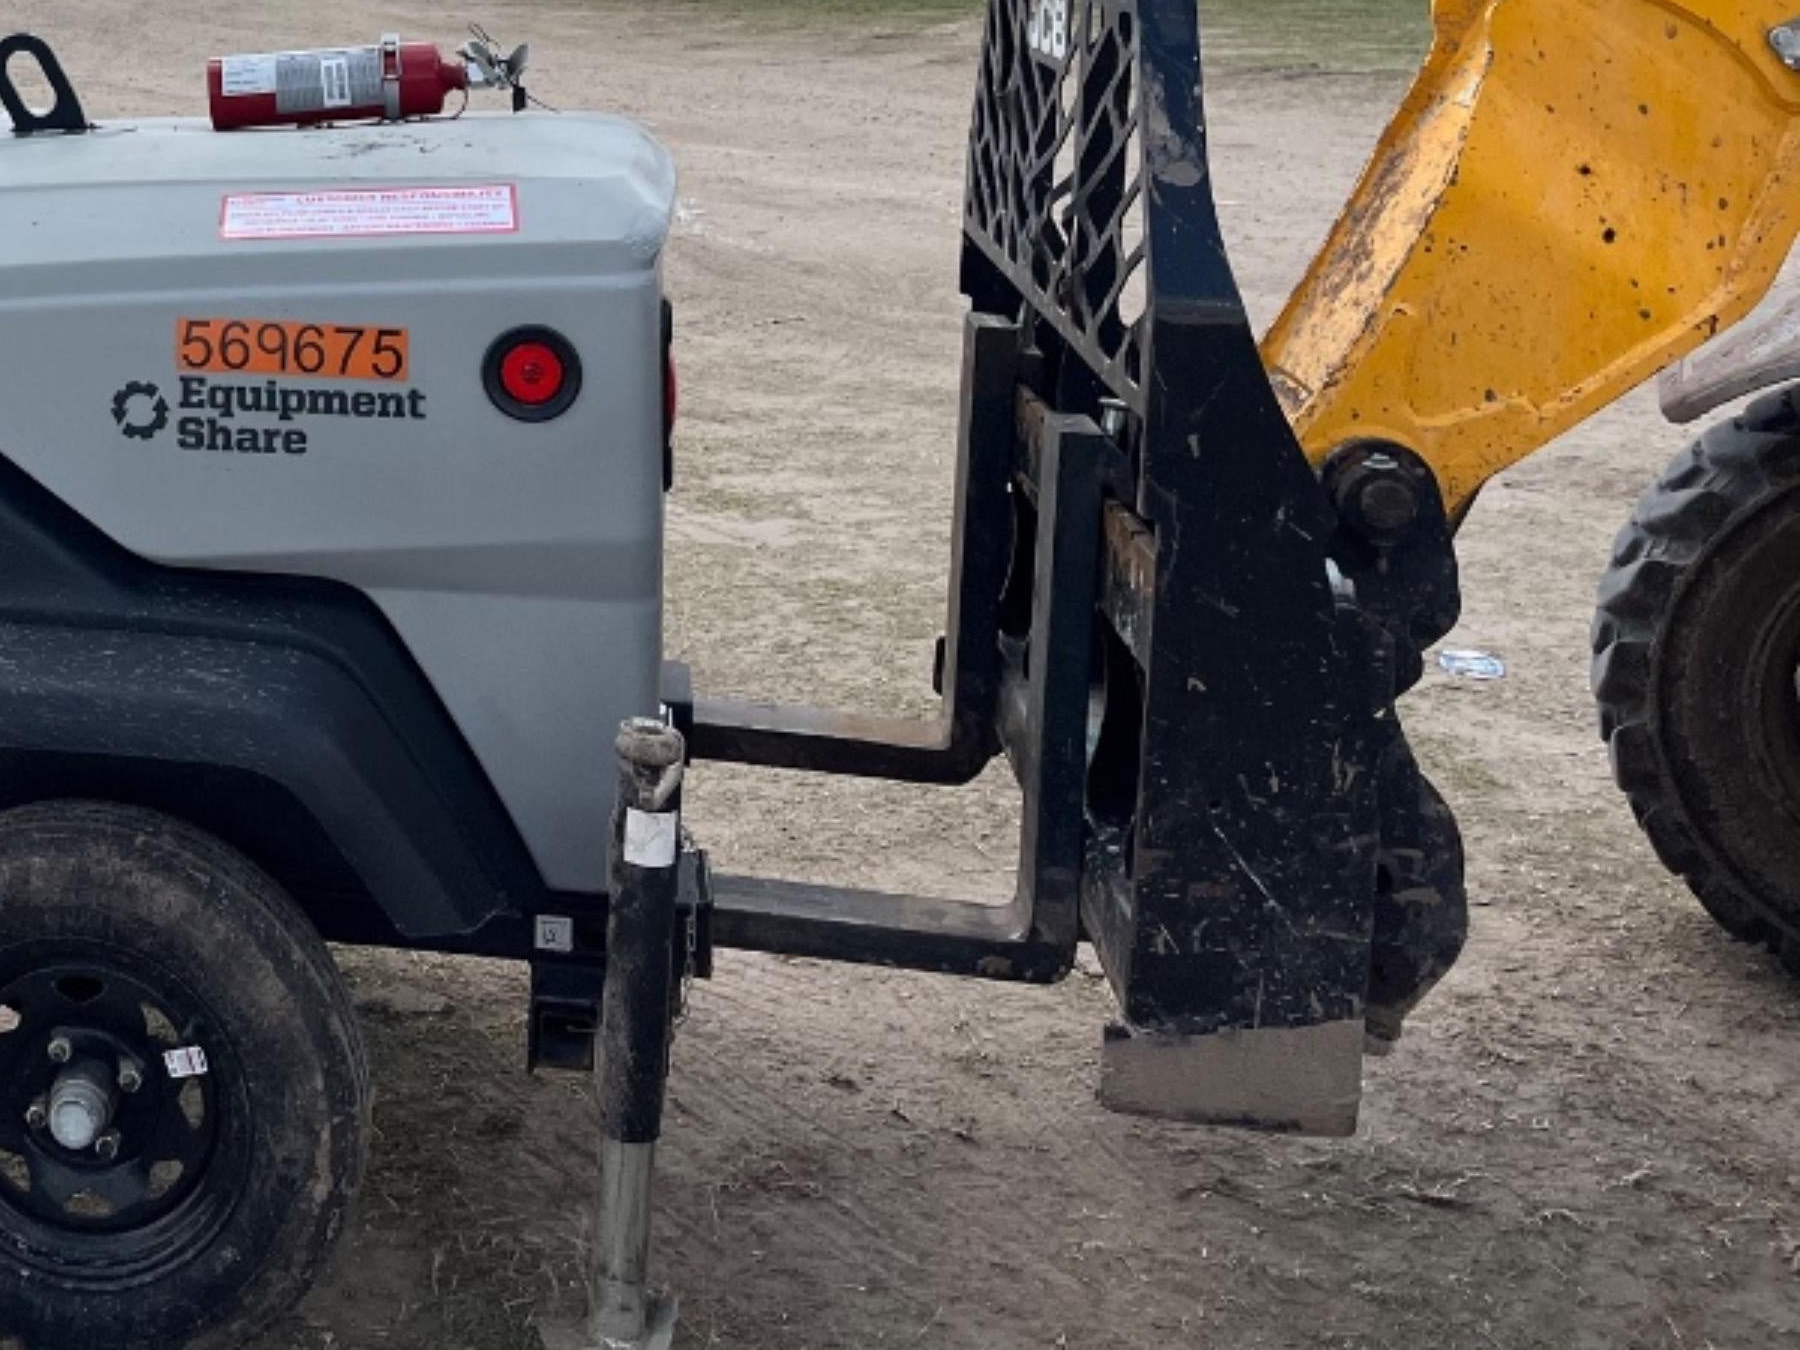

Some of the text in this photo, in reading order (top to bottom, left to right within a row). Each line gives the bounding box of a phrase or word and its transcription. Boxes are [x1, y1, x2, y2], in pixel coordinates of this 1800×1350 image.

[181, 319, 403, 378] 569675
[178, 375, 426, 421] Equipment
[177, 418, 307, 454] Share
